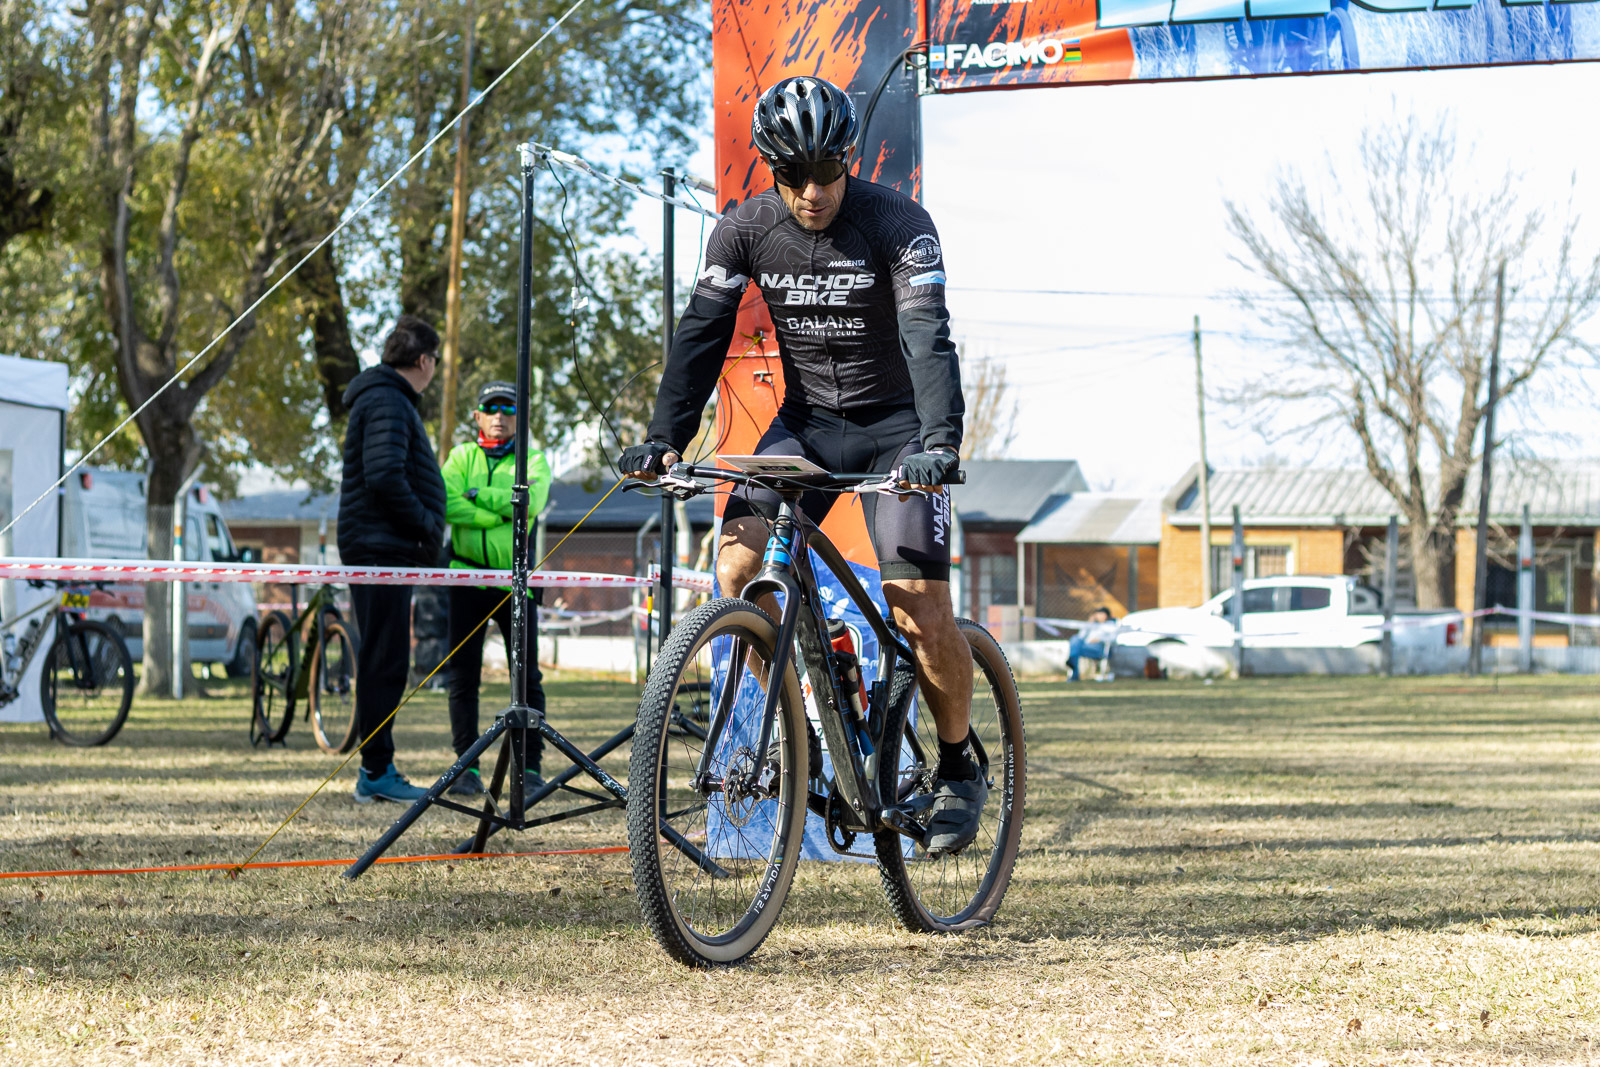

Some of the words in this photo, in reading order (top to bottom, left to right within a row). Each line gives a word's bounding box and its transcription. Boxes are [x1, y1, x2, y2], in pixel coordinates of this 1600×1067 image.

[946, 39, 1063, 69] FACIMO
[760, 273, 875, 290] NACHOS
[784, 290, 850, 305] BIKE
[1007, 743, 1015, 811] ALEXRIMS
[761, 863, 781, 901] VOLAR
[753, 900, 765, 914] 2.1
